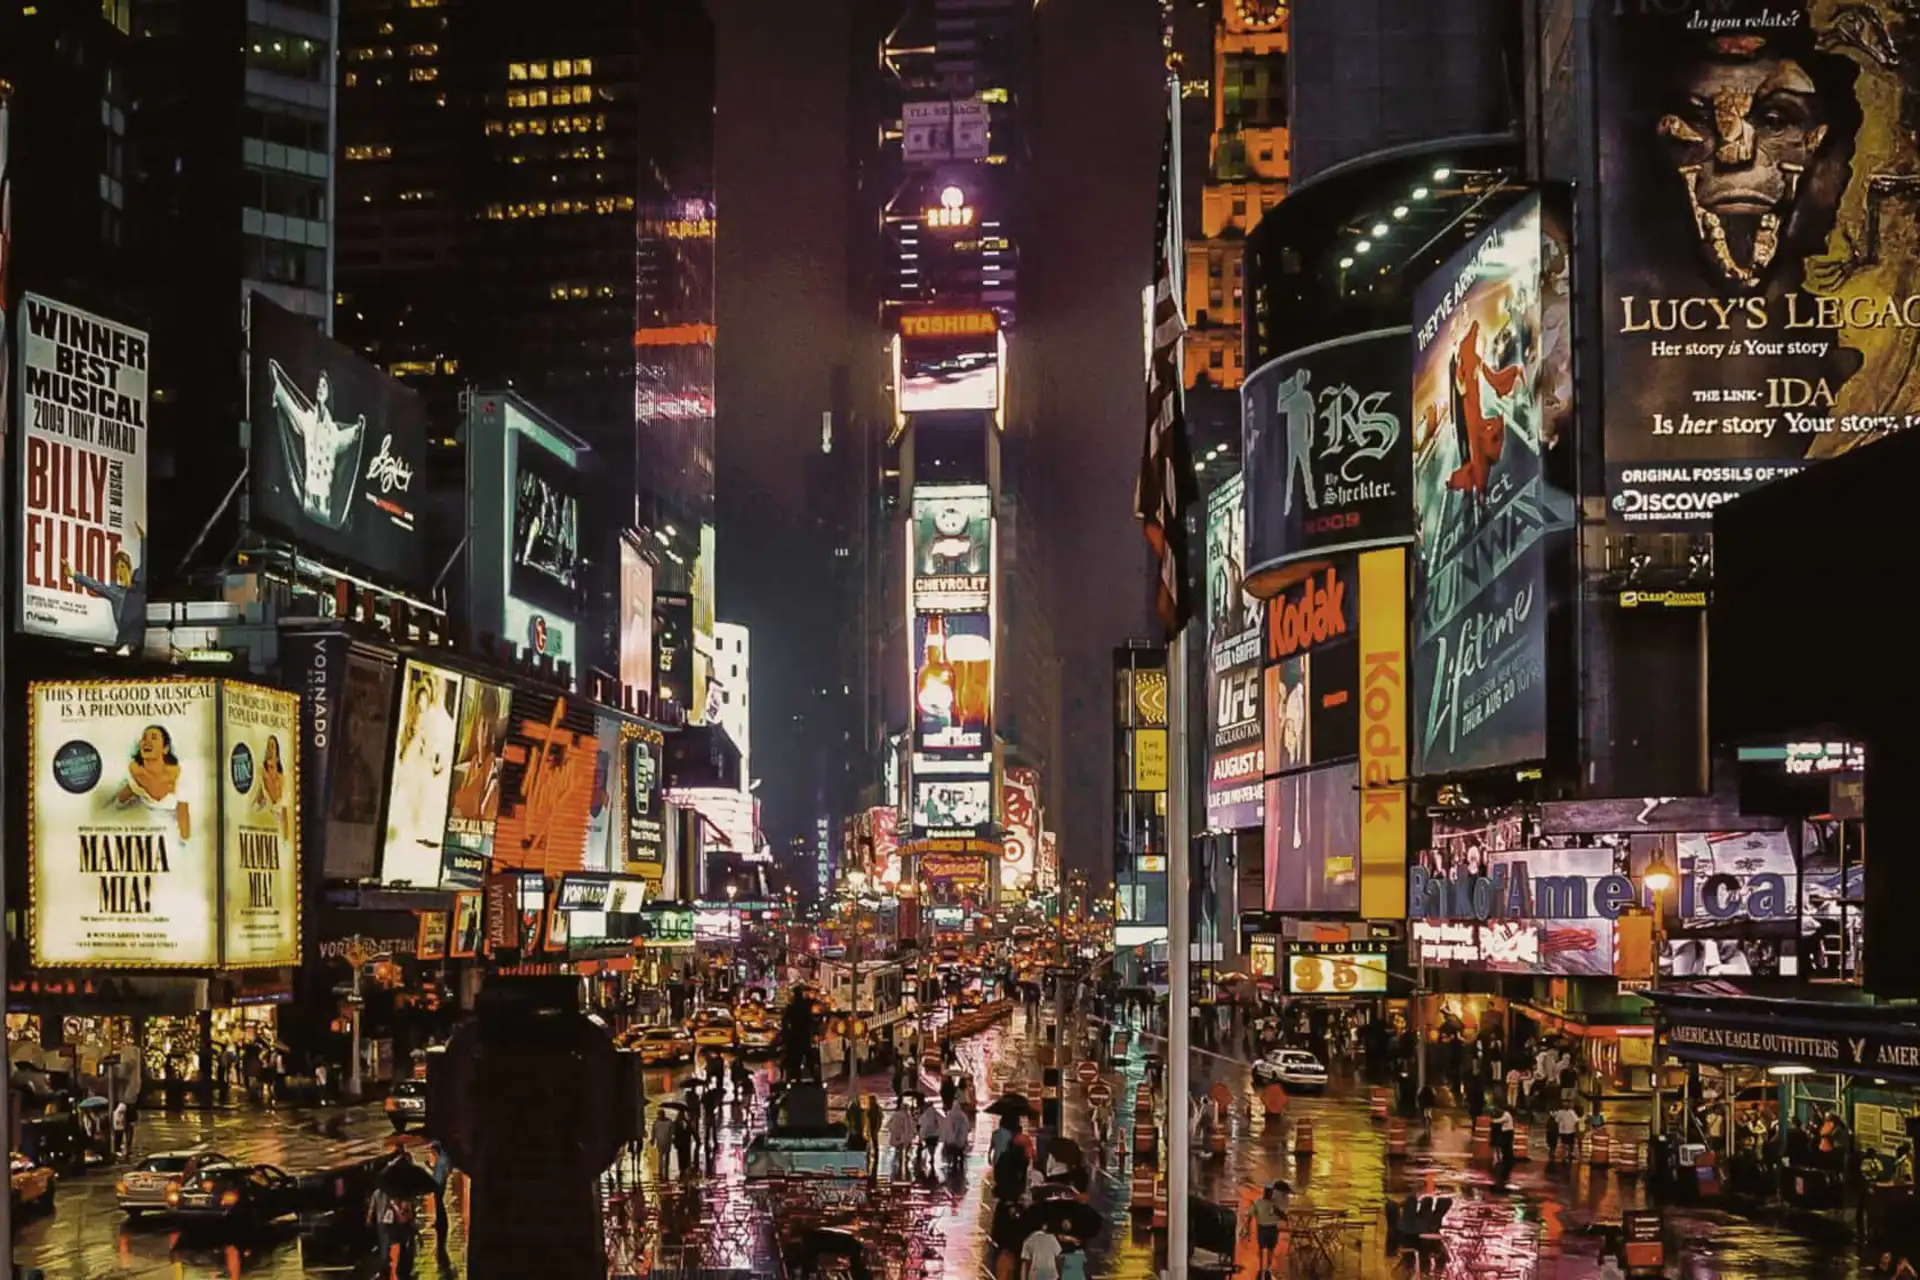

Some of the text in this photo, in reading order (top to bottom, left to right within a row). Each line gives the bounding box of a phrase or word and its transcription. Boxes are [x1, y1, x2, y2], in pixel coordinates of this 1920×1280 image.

[1687, 8, 1800, 33] do you relate?
[901, 313, 996, 336] TOSHIBA
[1416, 291, 1454, 352] THEY'VE
[1619, 293, 1920, 333] LUCY'S LEGAC
[27, 299, 147, 371] WINNER
[1651, 340, 1830, 359] Her story is Your story
[56, 343, 121, 391] BEST
[26, 366, 145, 429] MUSICAL
[1692, 390, 1720, 402] THE
[1765, 377, 1837, 408] IDA
[33, 400, 137, 455] 2009 TONY AWARD
[1652, 415, 1675, 435] Is
[1677, 414, 1719, 434] her
[1722, 417, 1778, 439] story
[1784, 413, 1835, 434] Your
[27, 436, 108, 525] BILLY
[109, 459, 125, 529] THE MUSICAL
[1621, 469, 1691, 484] ORIGINAL
[1692, 468, 1754, 482] FOSSILS
[1756, 467, 1776, 480] OF
[915, 576, 988, 592] CHEVROLET
[1267, 567, 1347, 660] Kodak
[1423, 578, 1534, 759] Lifetime
[60, 703, 73, 717] IS
[77, 703, 87, 717] A
[77, 686, 150, 701] FEEL-GOOD
[154, 684, 213, 700] MUSICAL
[313, 638, 327, 749] VORNADO
[1217, 668, 1258, 727] UFC
[1215, 721, 1261, 747] DECLARATION
[1364, 651, 1400, 824] Kodak
[1213, 749, 1265, 780] AUGUST 8
[78, 833, 170, 873] MAMMA
[238, 831, 281, 871] MAMMA
[98, 874, 152, 914] MIA!
[248, 871, 273, 908] MIA!
[1289, 942, 1388, 953] MARQUIS
[1670, 1025, 1840, 1060] AMERICAN EAGLE OUTFITTERS
